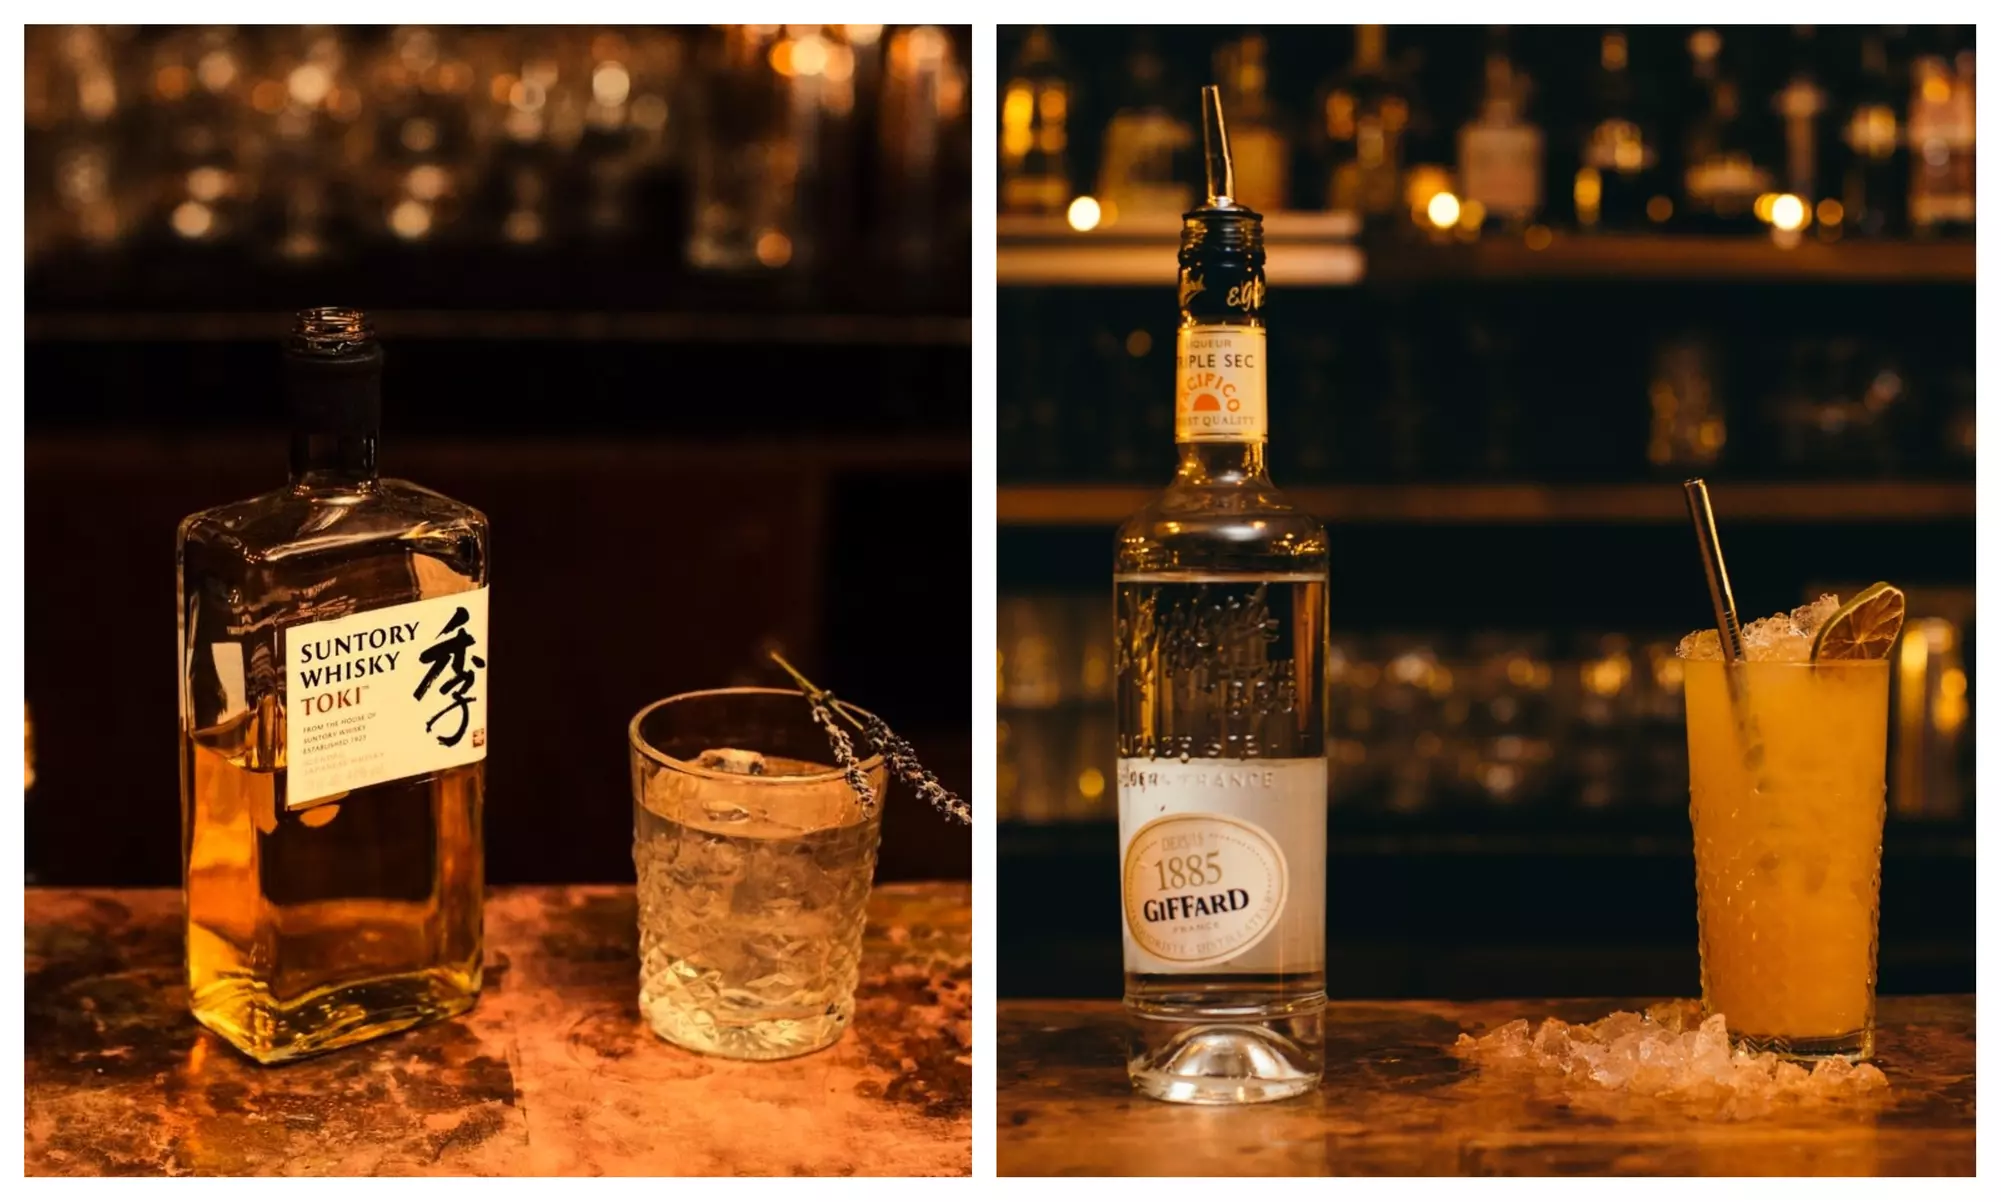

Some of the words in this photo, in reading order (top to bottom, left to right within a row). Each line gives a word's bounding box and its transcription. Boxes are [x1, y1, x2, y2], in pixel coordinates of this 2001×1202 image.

[1224, 353, 1254, 368] SEC
[300, 621, 420, 664] SUNTORY
[300, 651, 400, 689] WHISKY
[413, 606, 486, 747] 季
[303, 723, 324, 734] FROM
[326, 719, 339, 729] THE
[341, 714, 365, 726] HOUSE
[303, 731, 337, 745] SUNTORY
[339, 725, 366, 736] WHISKY
[302, 739, 349, 755] ESTABLISHED
[1154, 849, 1223, 891] 1885
[1143, 888, 1250, 923] GIFFARD
[1173, 921, 1220, 934] FRANCE
